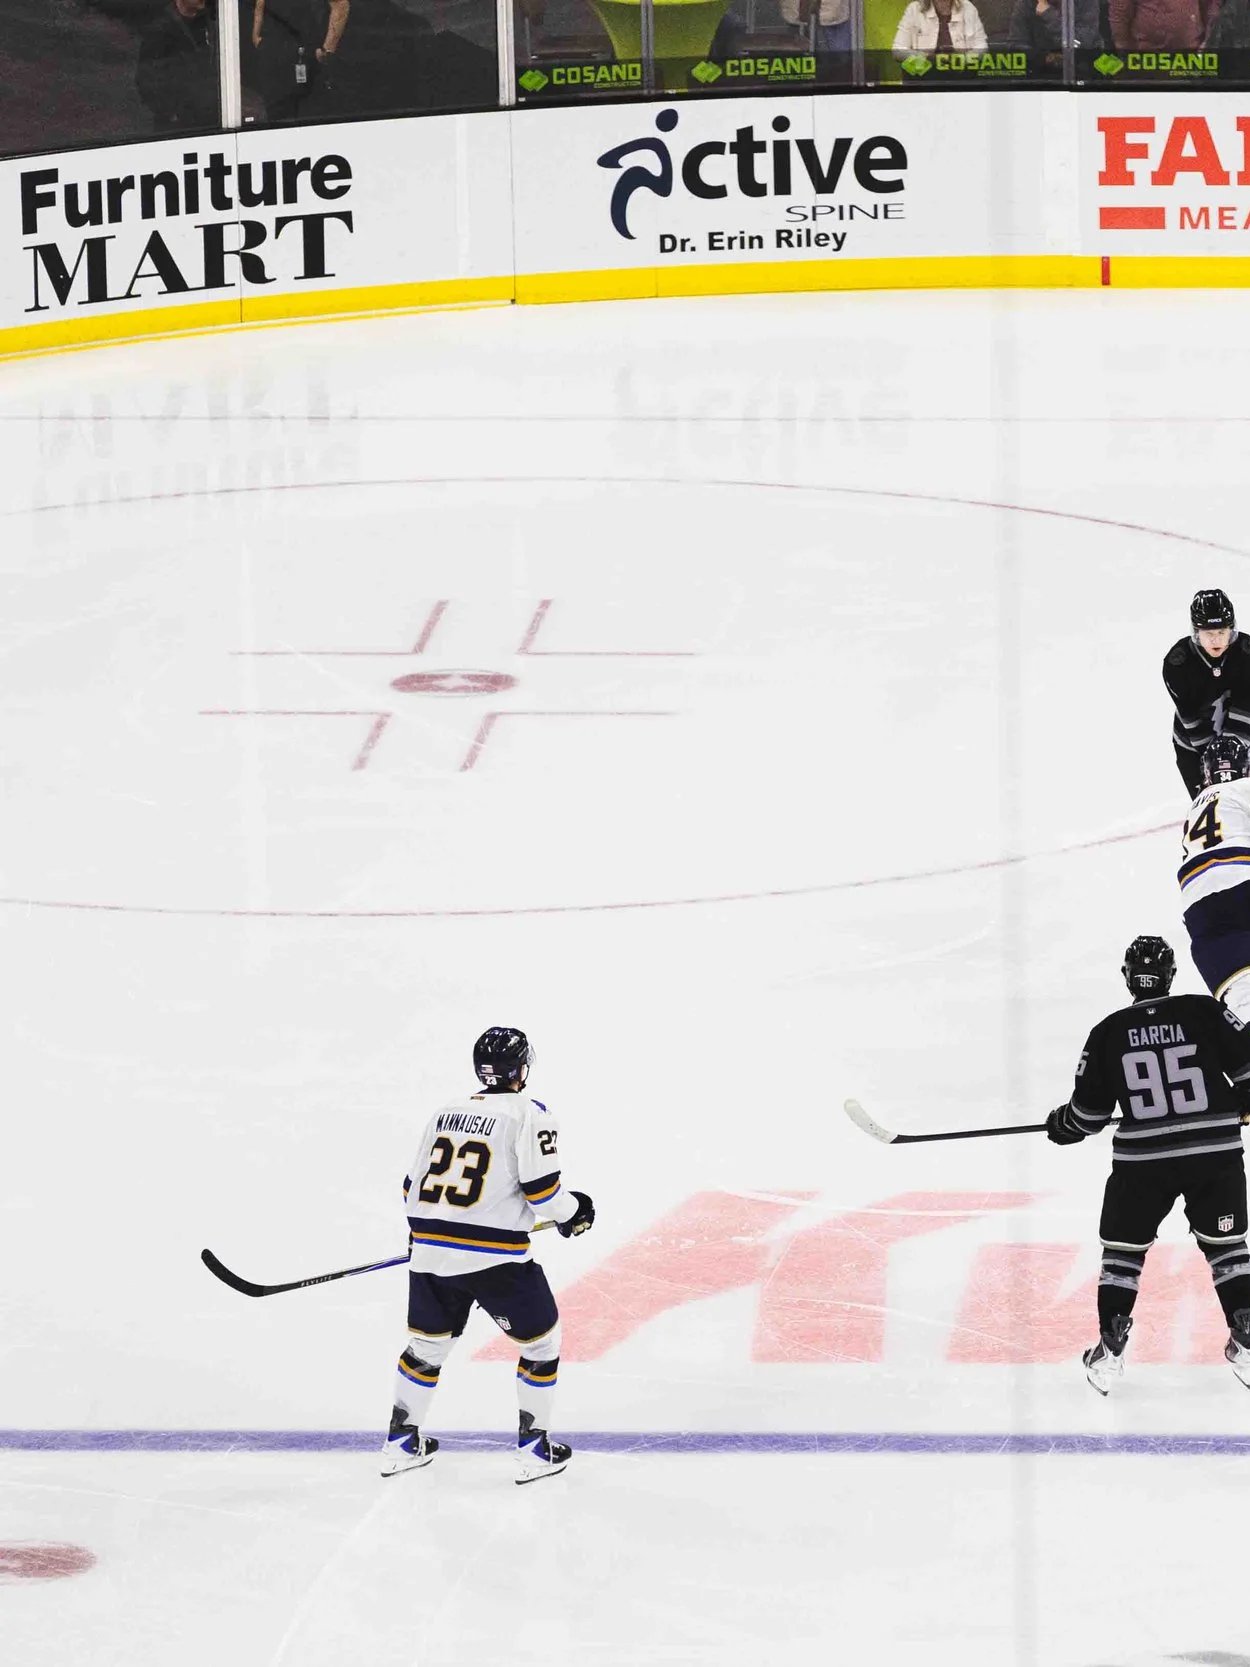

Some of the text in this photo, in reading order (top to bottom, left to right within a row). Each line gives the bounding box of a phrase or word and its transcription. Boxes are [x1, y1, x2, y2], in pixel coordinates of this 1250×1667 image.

[20, 152, 353, 235] Furniture
[785, 202, 906, 223] SPINE
[22, 210, 354, 313] MART
[659, 228, 848, 254] Dr. Erin Riley
[1127, 1023, 1186, 1047] GARCIA
[1121, 1043, 1209, 1121] 95
[418, 1135, 493, 1209] 23
